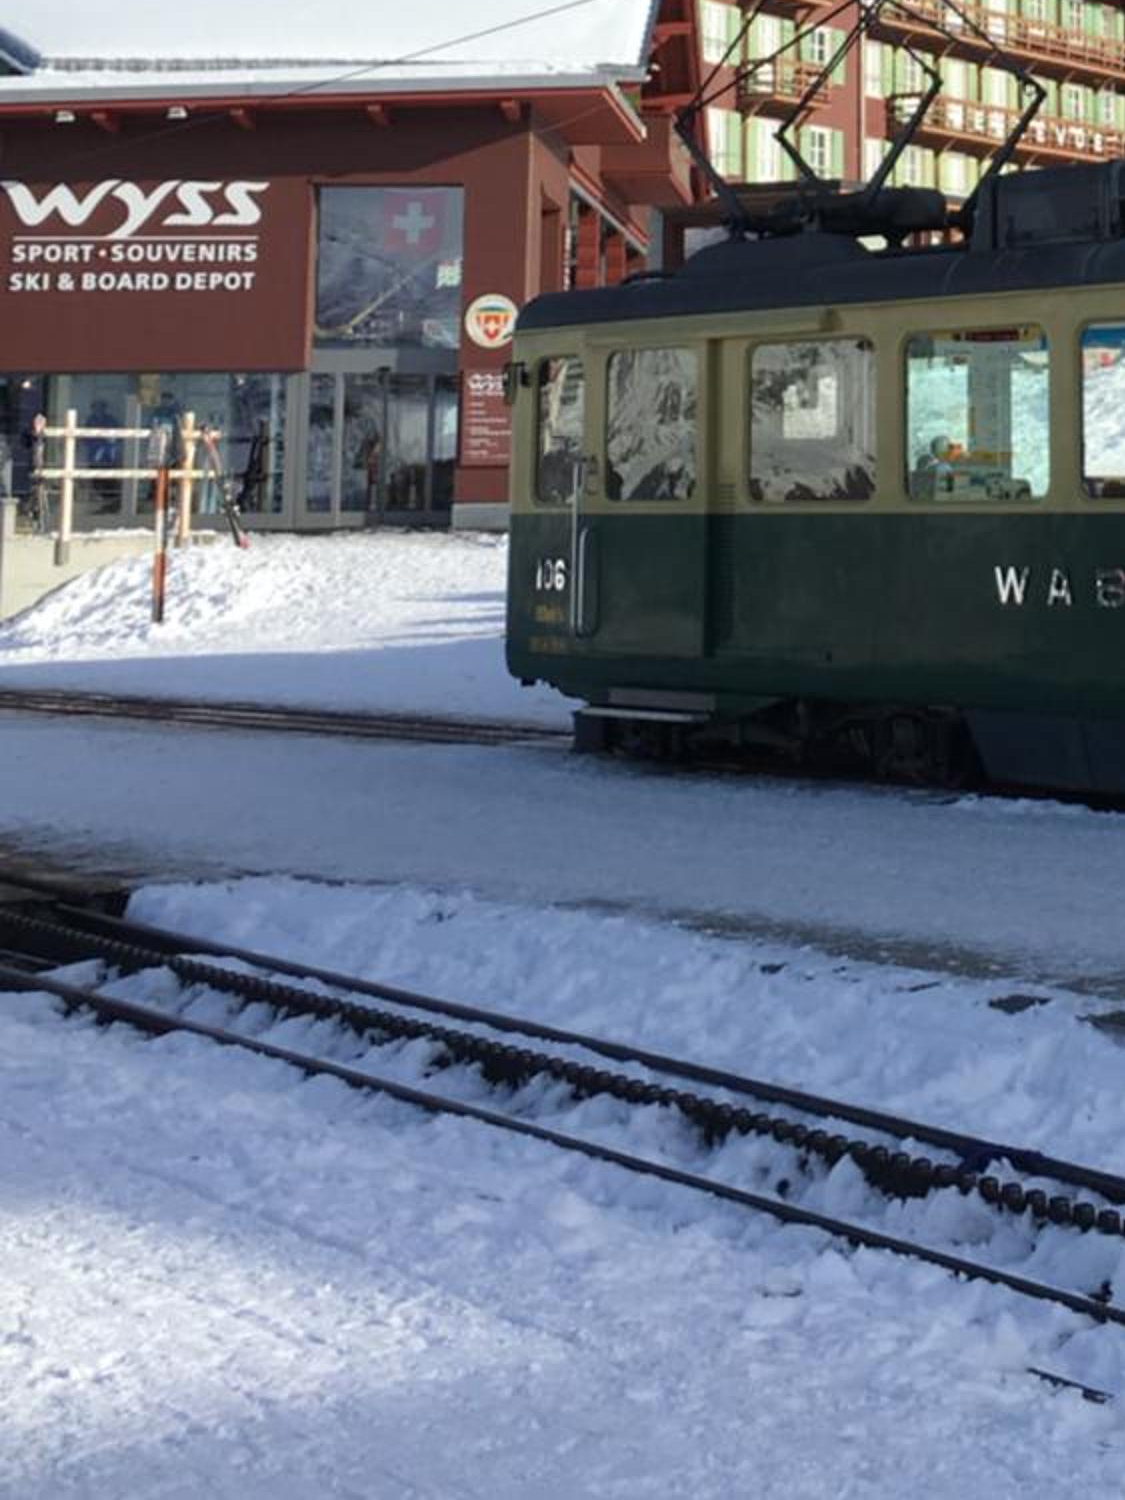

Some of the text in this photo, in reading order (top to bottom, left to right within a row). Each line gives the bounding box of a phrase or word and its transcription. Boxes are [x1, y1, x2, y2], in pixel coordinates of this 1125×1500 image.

[12, 243, 258, 263] SPORT SOUVENIRS
[8, 271, 256, 291] SKI & BOARD DEPOT
[536, 559, 566, 591] 106
